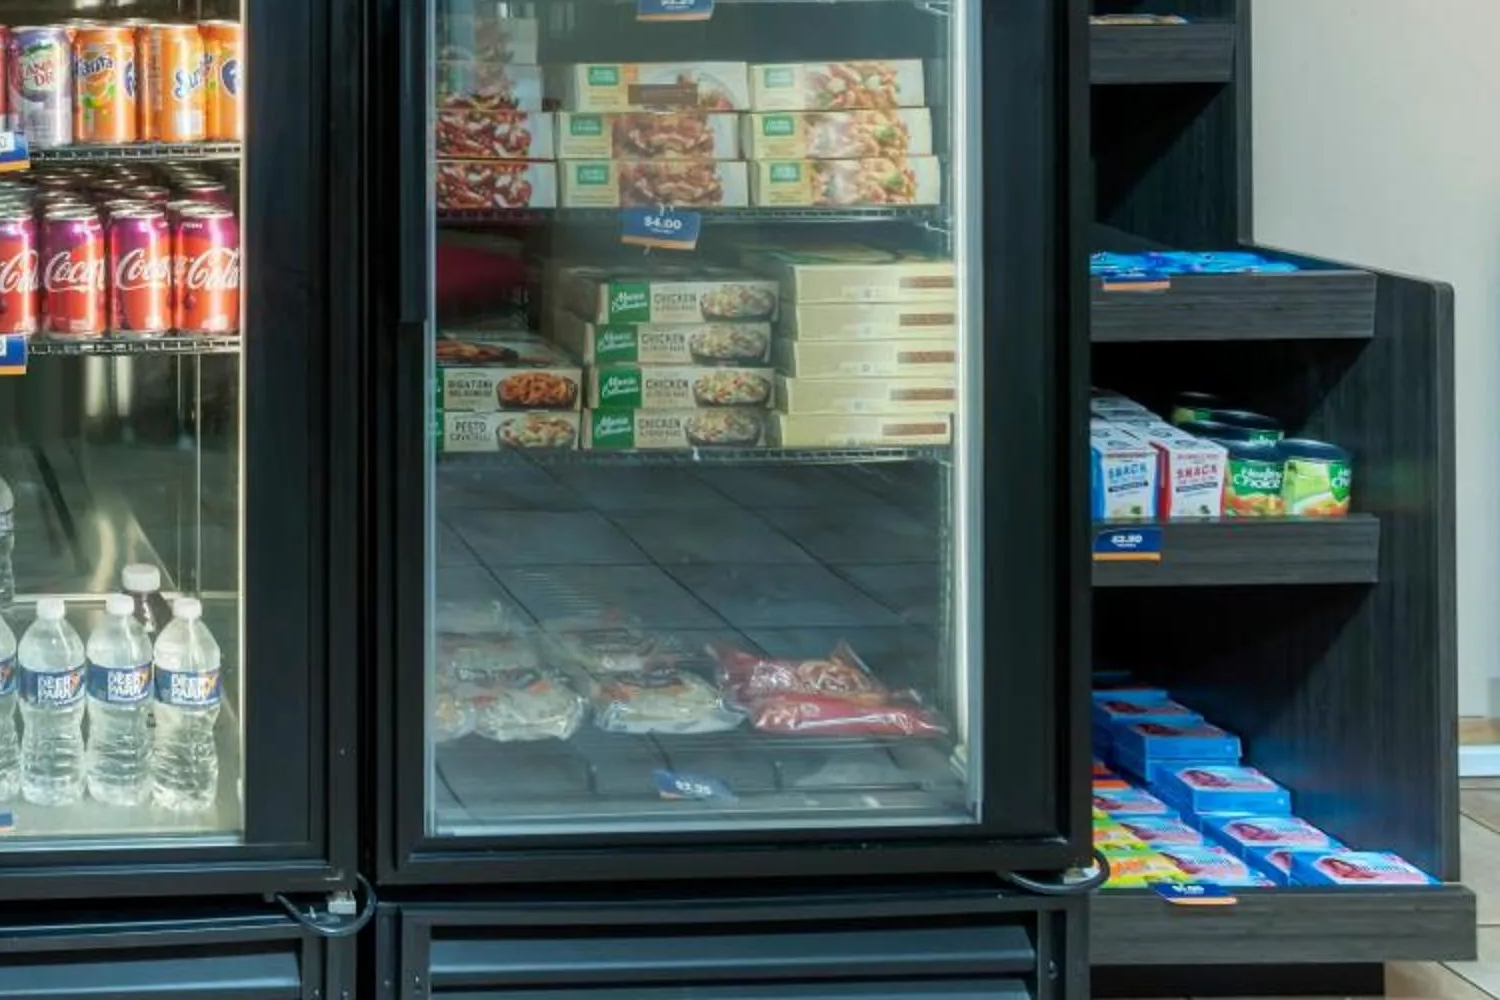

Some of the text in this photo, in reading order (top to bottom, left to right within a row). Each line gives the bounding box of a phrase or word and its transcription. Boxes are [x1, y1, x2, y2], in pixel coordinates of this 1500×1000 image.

[641, 332, 686, 344] CHICKEN
[645, 379, 689, 389] CHICKEN
[455, 421, 486, 433] PESTO
[1175, 464, 1218, 480] SNACK
